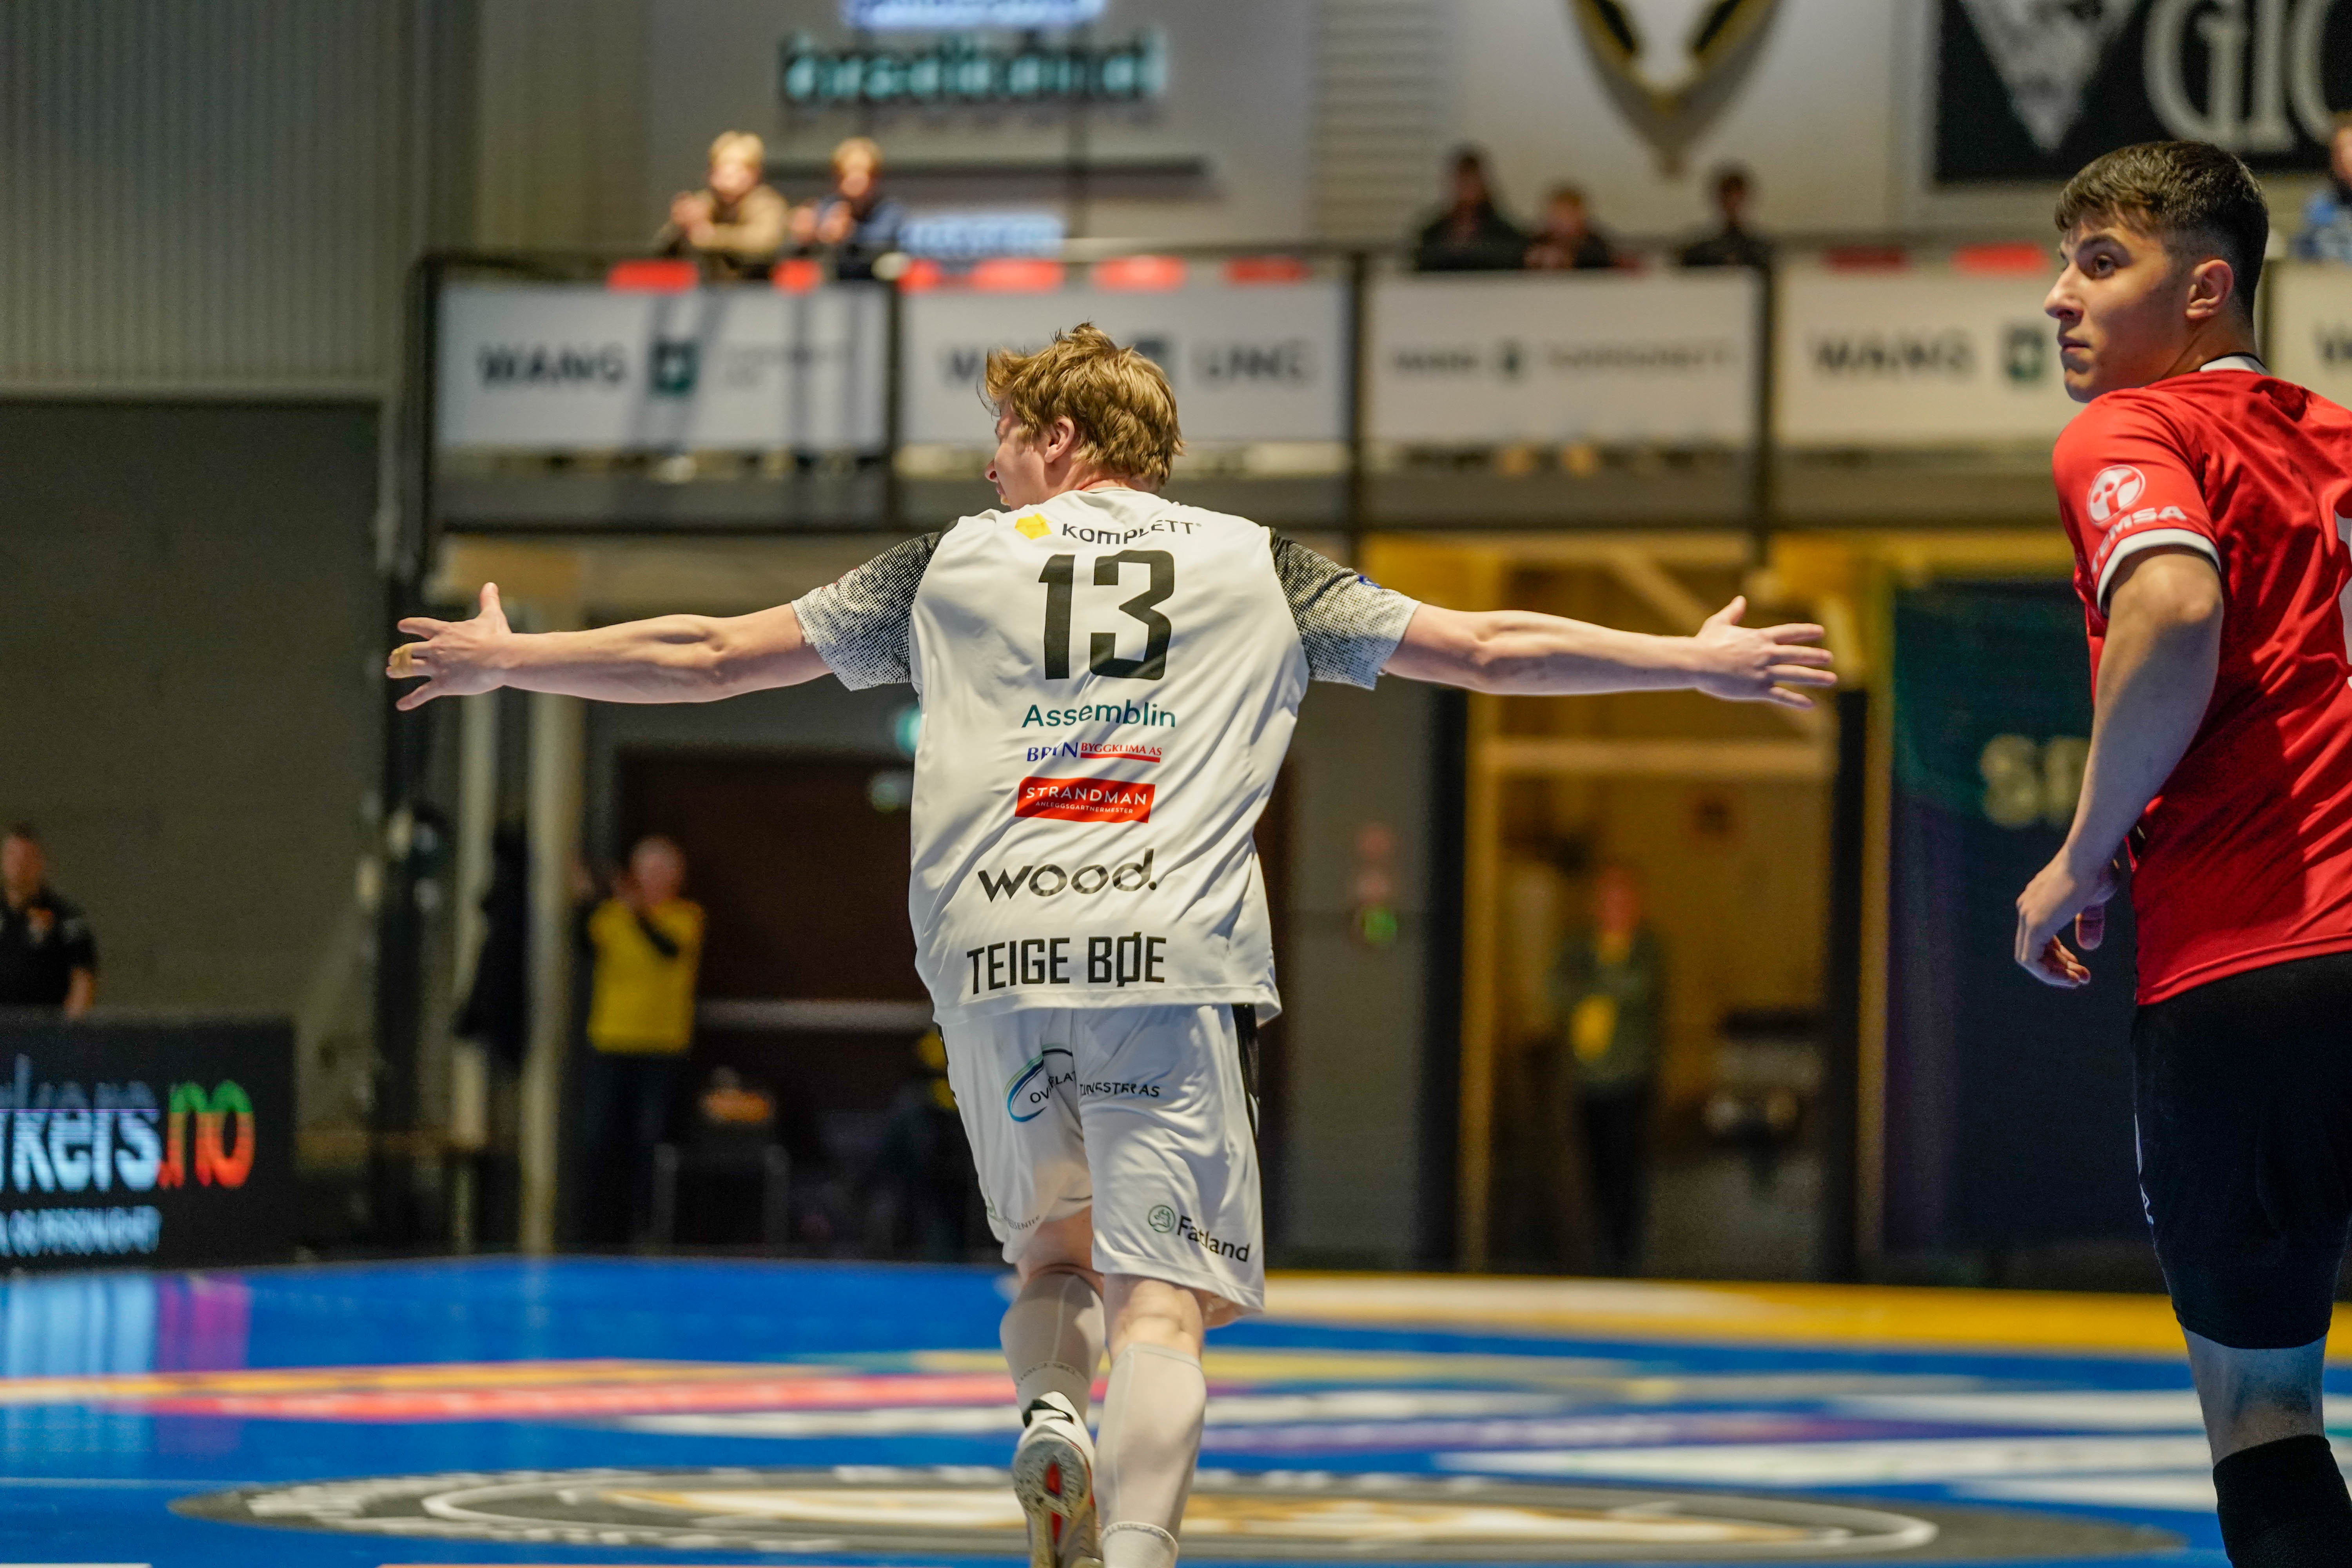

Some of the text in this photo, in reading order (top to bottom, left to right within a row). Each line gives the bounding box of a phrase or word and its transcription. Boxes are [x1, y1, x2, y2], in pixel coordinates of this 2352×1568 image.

[1038, 550, 1174, 680] 13
[1022, 699, 1176, 728] Assemblin
[1081, 742, 1146, 755] BYGGKLIMA
[1149, 747, 1162, 756] AS
[1025, 786, 1147, 805] STRANDMAN
[1035, 800, 1133, 814] ANLEGGSGARTNERMESTER
[967, 931, 1167, 995] TEIGE BØE
[1139, 1084, 1161, 1098] AS
[0, 1054, 256, 1192] kers.no
[1177, 1214, 1251, 1262] Fatland
